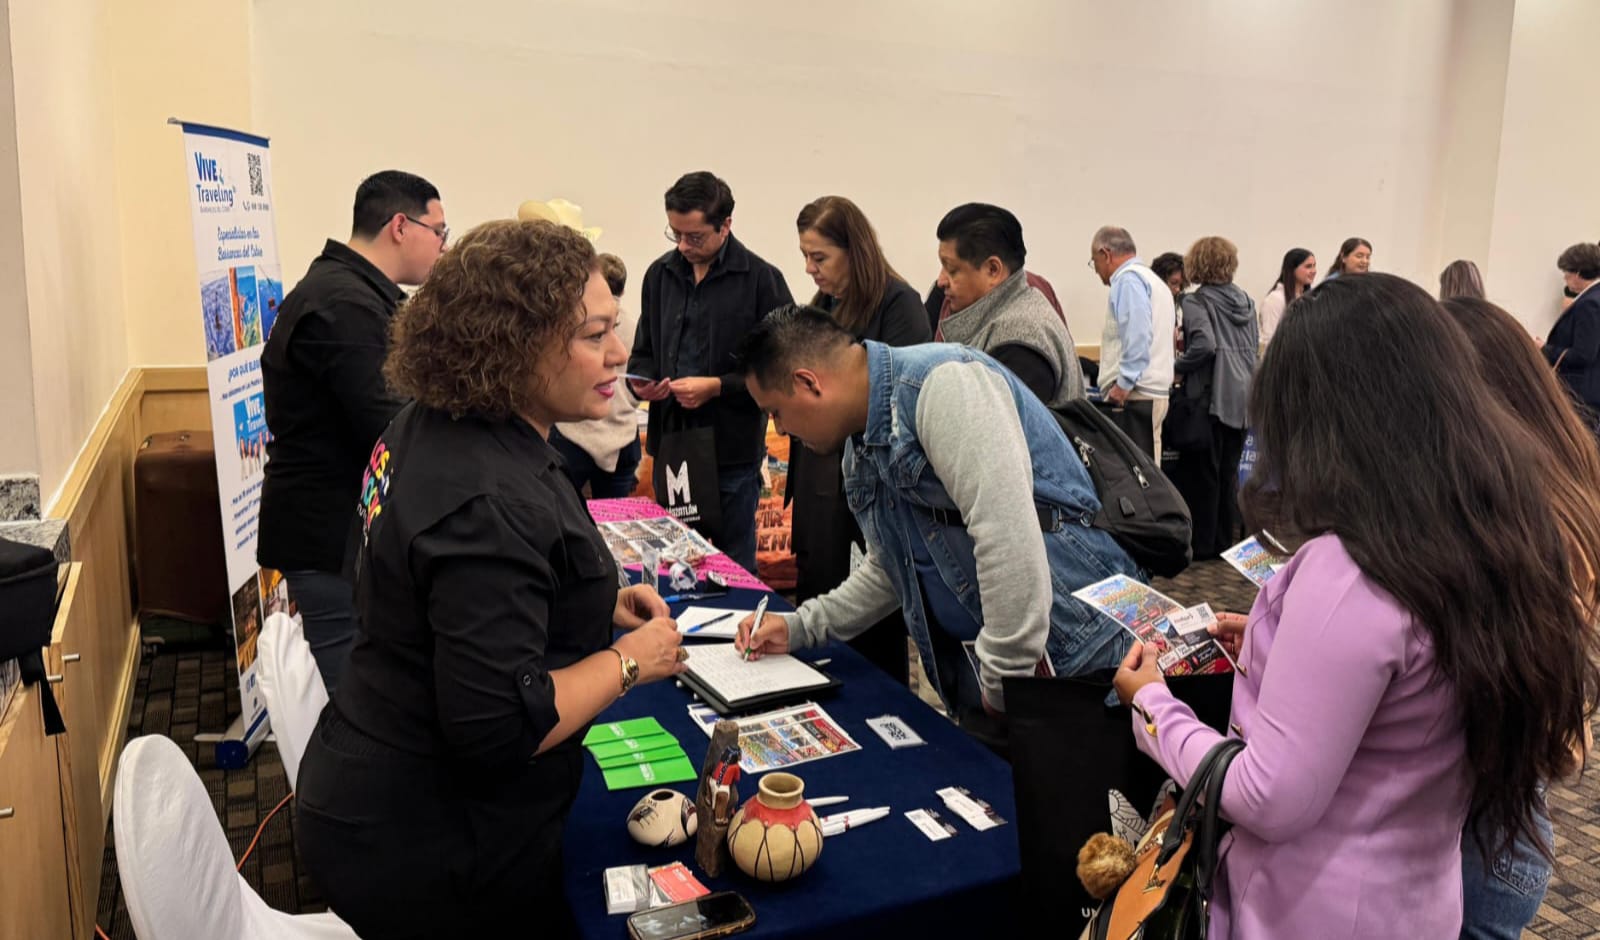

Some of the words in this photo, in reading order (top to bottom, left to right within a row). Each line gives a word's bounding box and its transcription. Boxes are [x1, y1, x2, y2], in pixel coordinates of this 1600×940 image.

[194, 152, 218, 181] VIVE
[196, 184, 234, 207] Traveling
[665, 460, 691, 506] M
